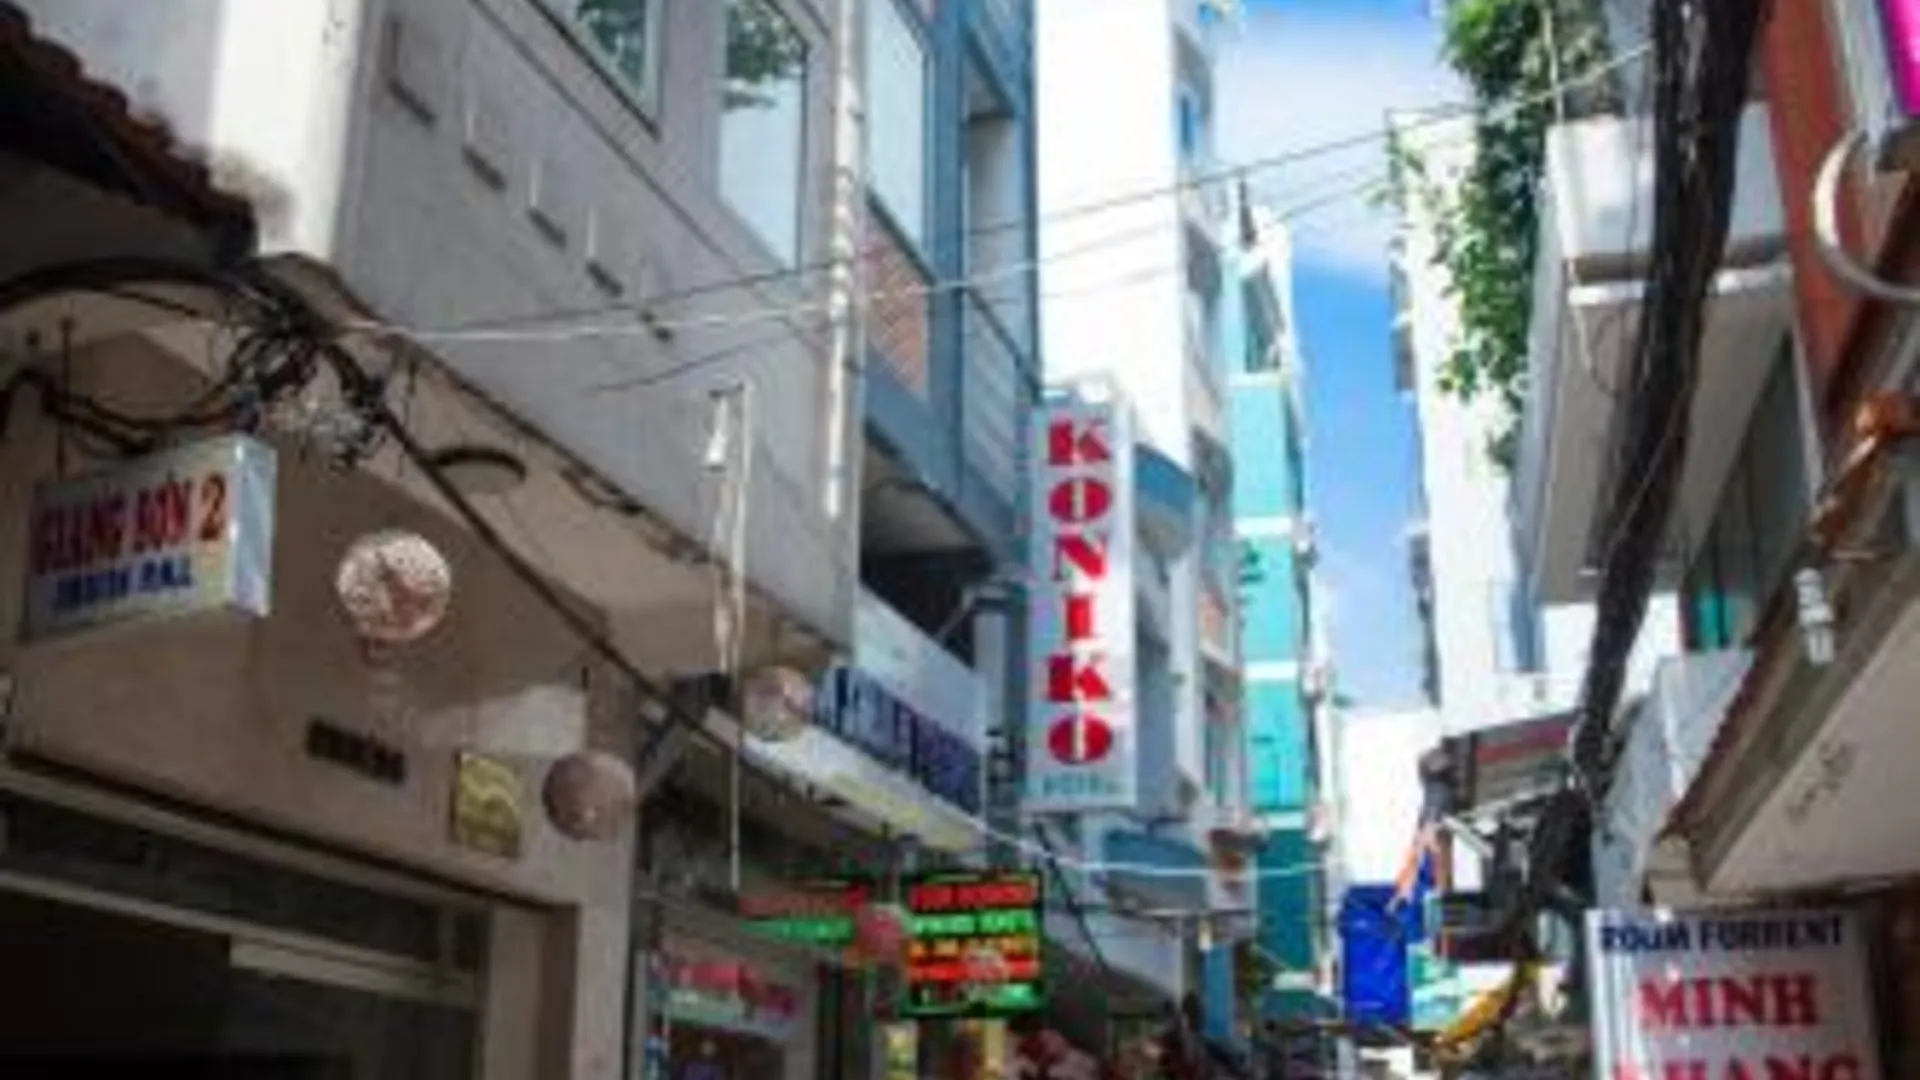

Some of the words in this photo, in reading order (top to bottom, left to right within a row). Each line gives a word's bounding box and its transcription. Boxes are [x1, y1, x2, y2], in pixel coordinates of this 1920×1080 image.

[200, 472, 227, 542] 2
[1047, 414, 1114, 766] KONIKO
[1601, 920, 1690, 950] ROOM
[1640, 974, 1819, 1027] MINH
